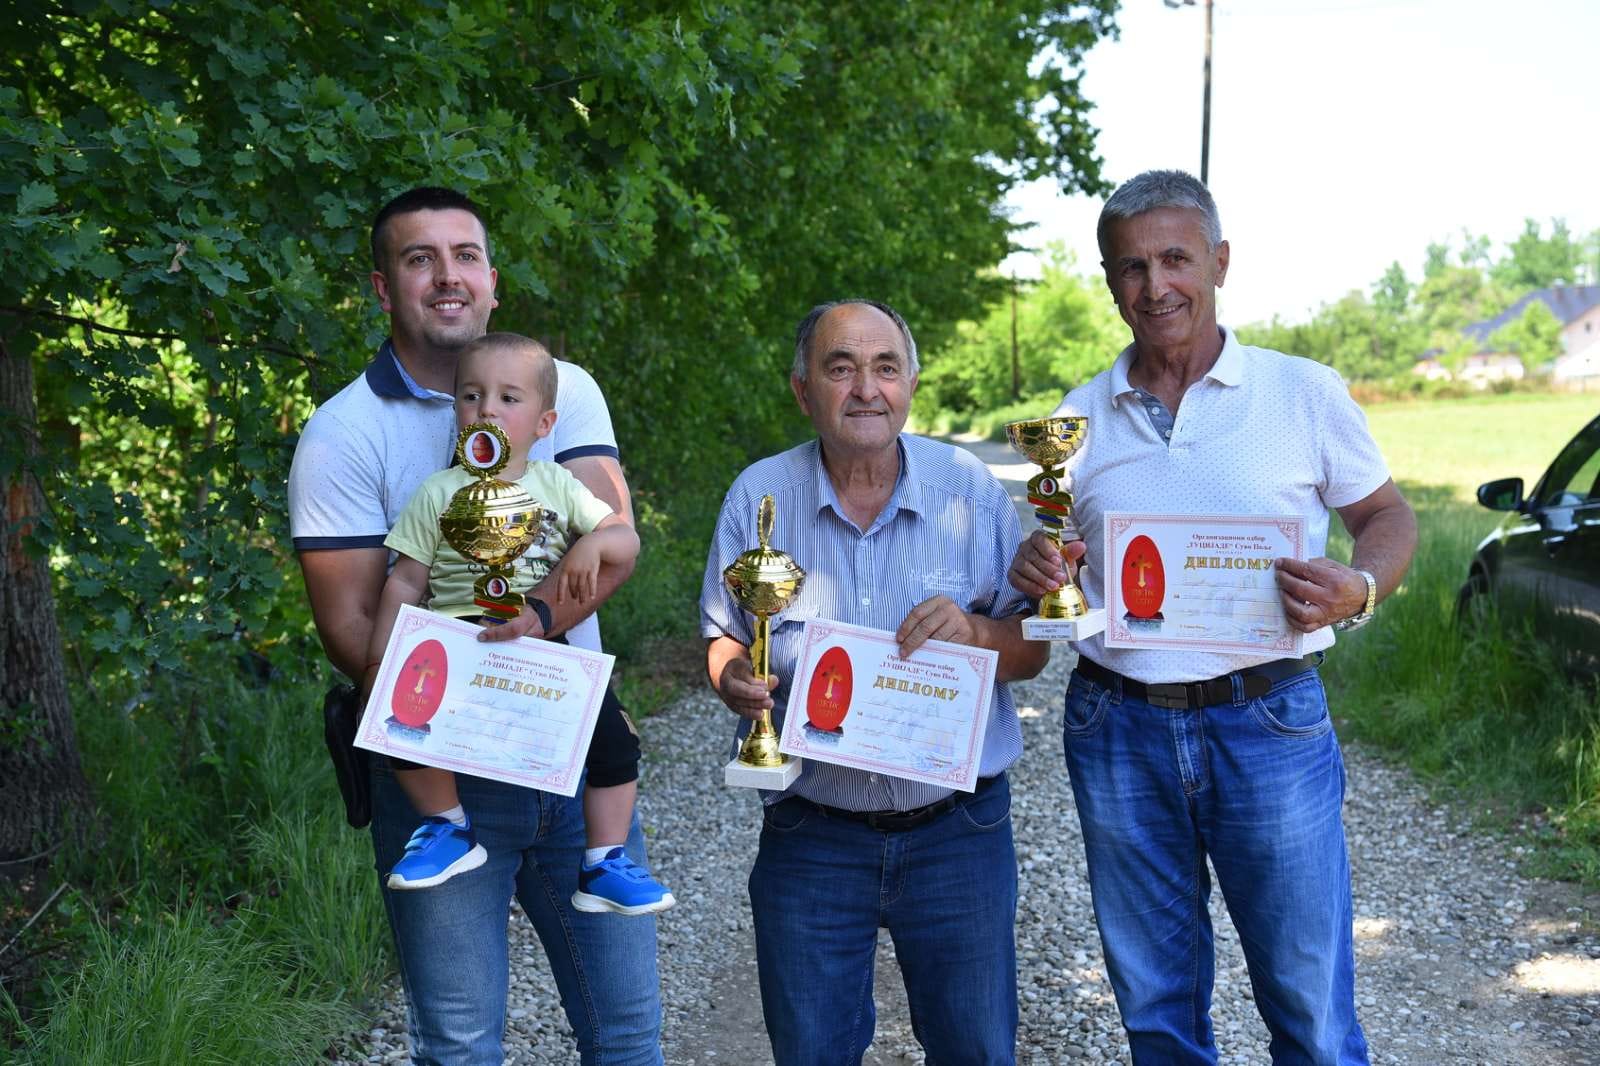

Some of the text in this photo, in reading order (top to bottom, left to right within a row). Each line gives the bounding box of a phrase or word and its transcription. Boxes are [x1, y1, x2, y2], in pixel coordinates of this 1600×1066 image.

[1184, 556, 1274, 571] ДИПЛОМУ
[469, 672, 568, 702] ДИПЛОМУ
[873, 674, 960, 701] ДИПЛОМУ
